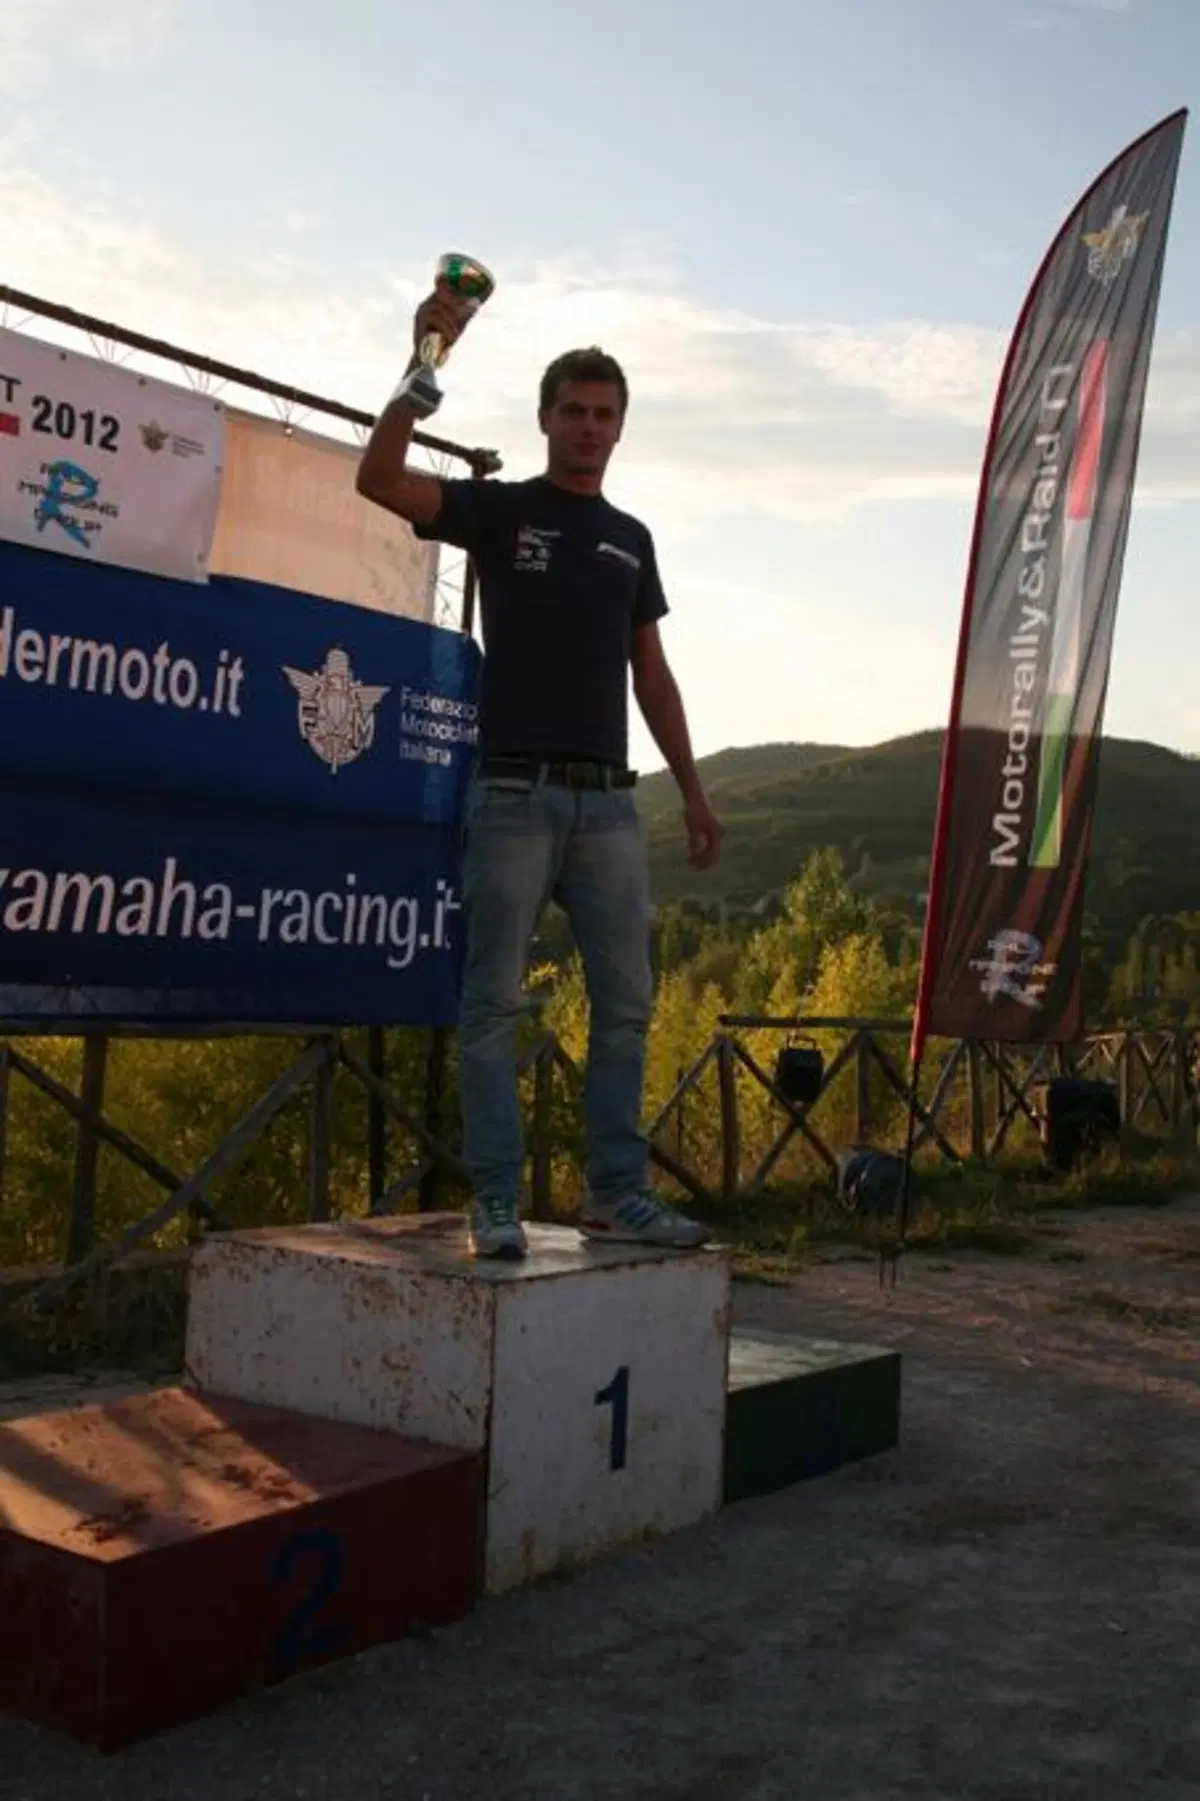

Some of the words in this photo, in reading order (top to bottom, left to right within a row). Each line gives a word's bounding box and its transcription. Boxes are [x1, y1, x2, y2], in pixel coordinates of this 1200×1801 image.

[31, 394, 120, 453] 2012
[0, 856, 463, 969] amaha-racing.it
[595, 1366, 629, 1471] 1
[268, 1527, 349, 1668] 2
